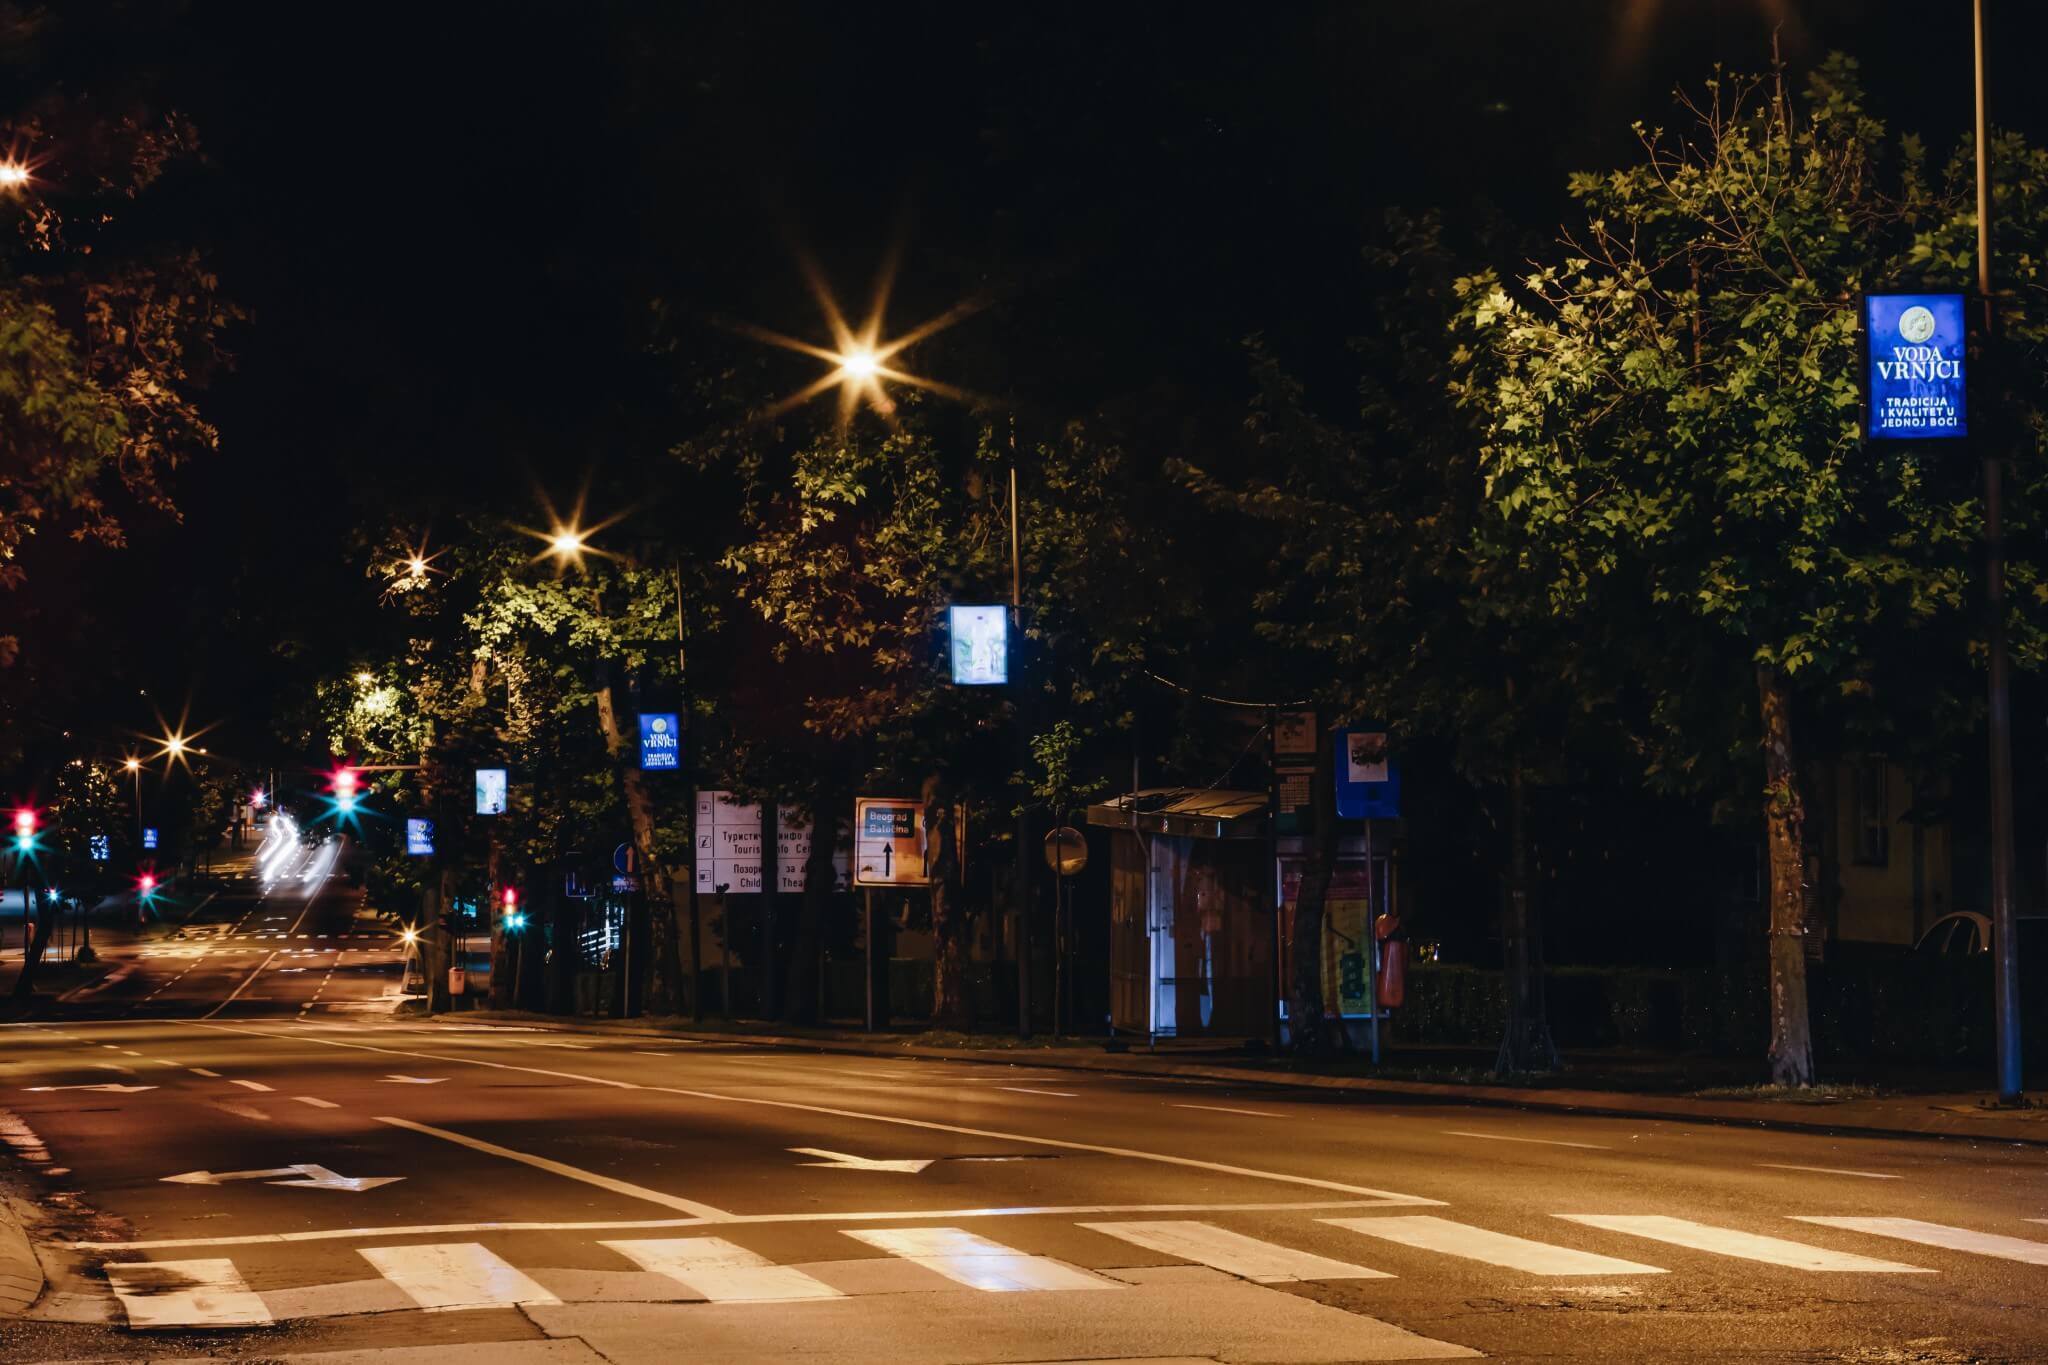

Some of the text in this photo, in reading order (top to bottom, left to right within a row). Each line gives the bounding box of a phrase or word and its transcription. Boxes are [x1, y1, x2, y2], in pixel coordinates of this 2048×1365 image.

[1893, 346, 1943, 361] VODA
[1877, 361, 1960, 382] VRNJCI
[1887, 397, 1948, 407] TRADICIJA
[1880, 407, 1955, 417] I KVALITET U
[1881, 417, 1958, 428] JEDNOJ BOCI
[870, 811, 907, 823] Beograd
[733, 844, 761, 854] Touris
[776, 844, 789, 853] nfo
[740, 877, 804, 888] Child Thea
